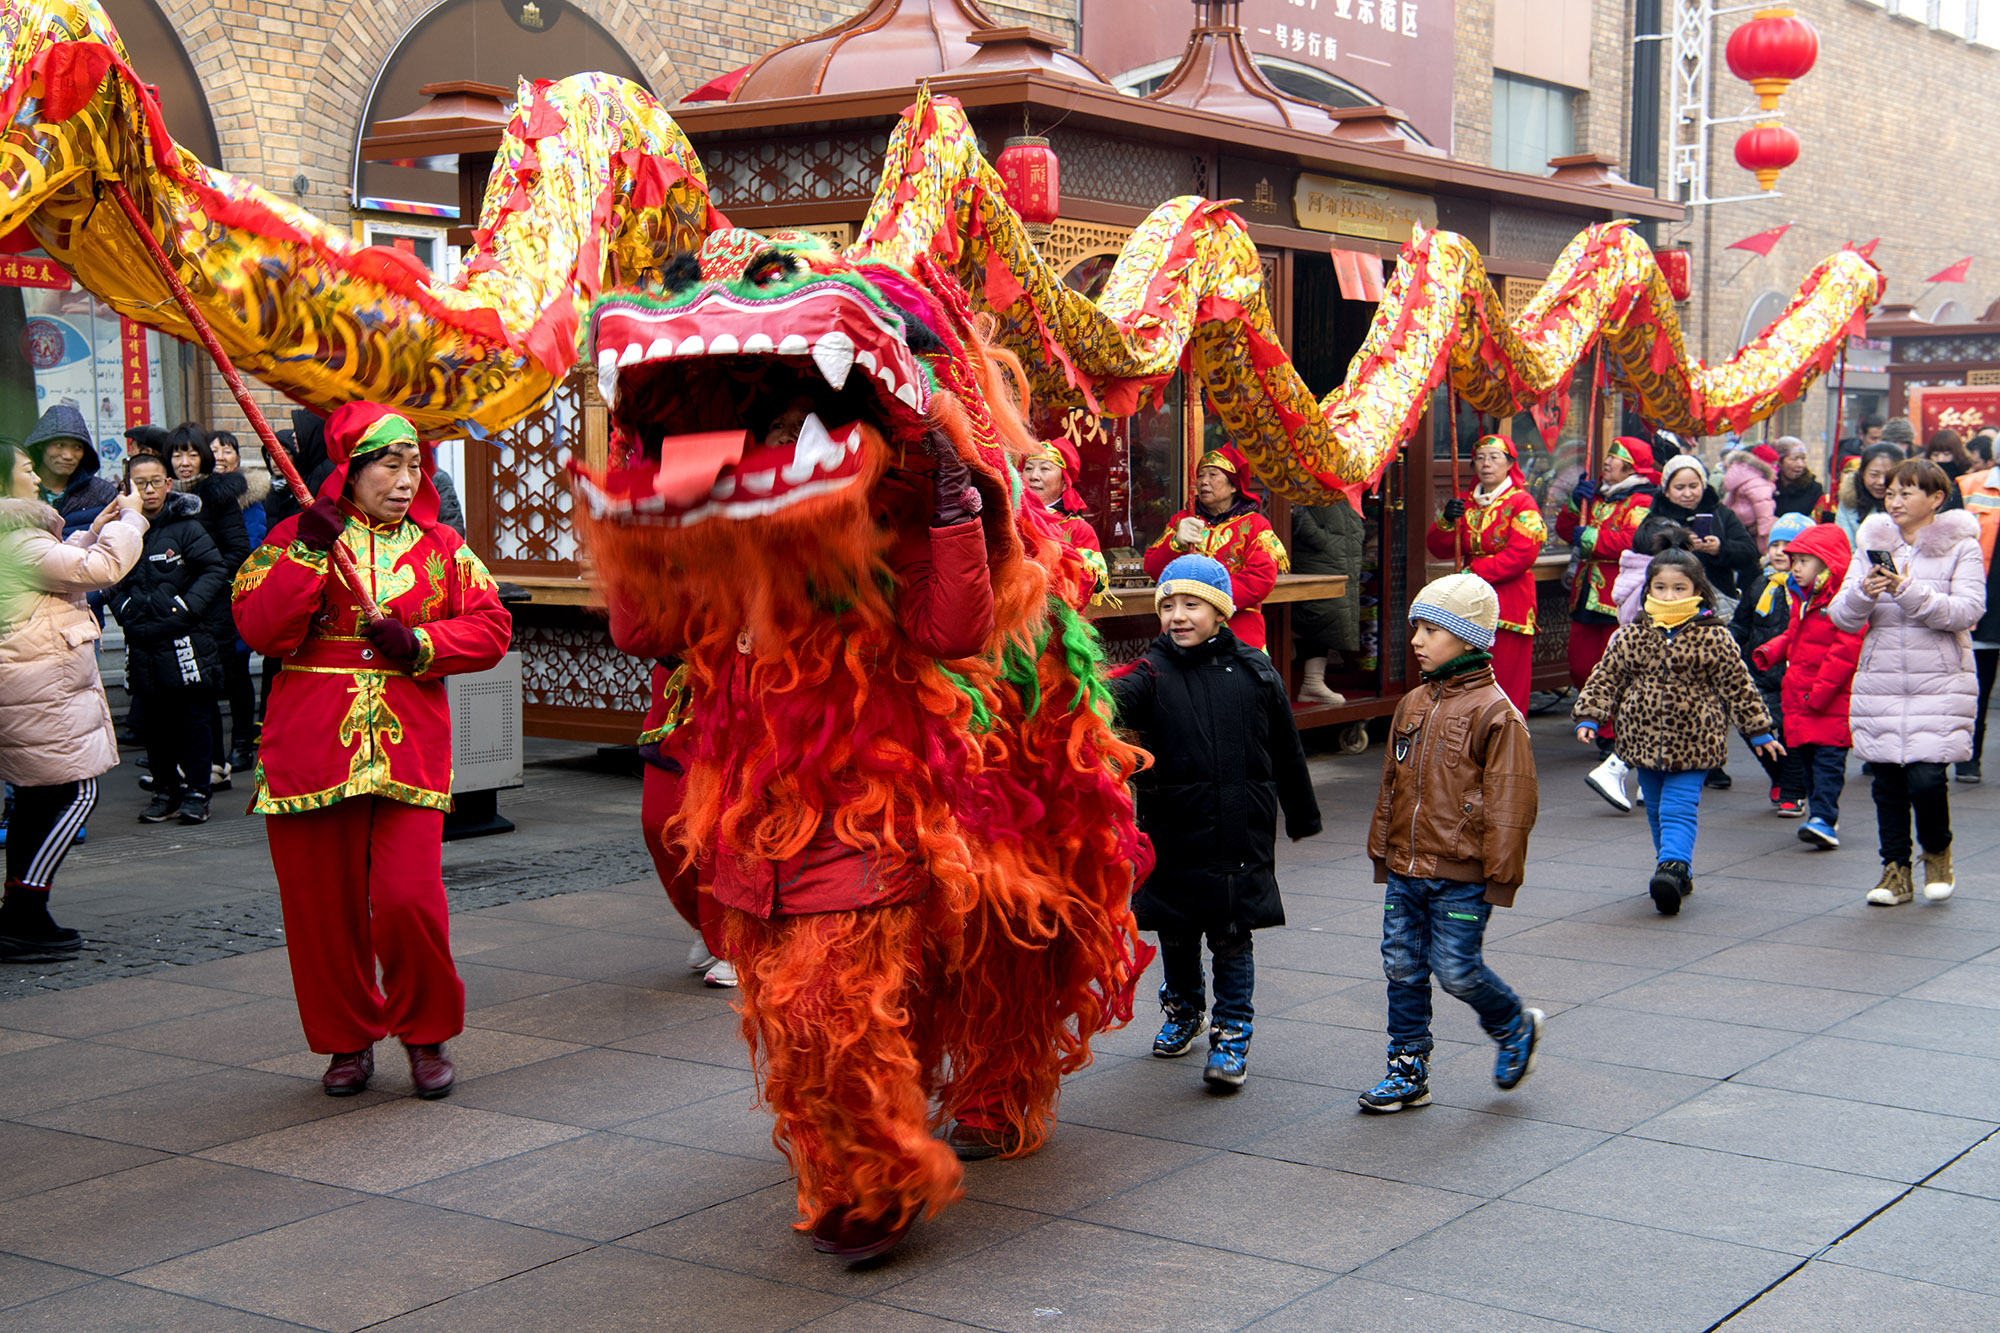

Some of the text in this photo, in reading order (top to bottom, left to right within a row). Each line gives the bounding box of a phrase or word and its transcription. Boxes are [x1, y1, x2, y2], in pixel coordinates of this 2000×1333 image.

[1289, 0, 1418, 38] 业示范区
[1257, 23, 1338, 61] 一号步行街
[0, 263, 54, 282] 福迎春
[174, 635, 202, 686] FREE
